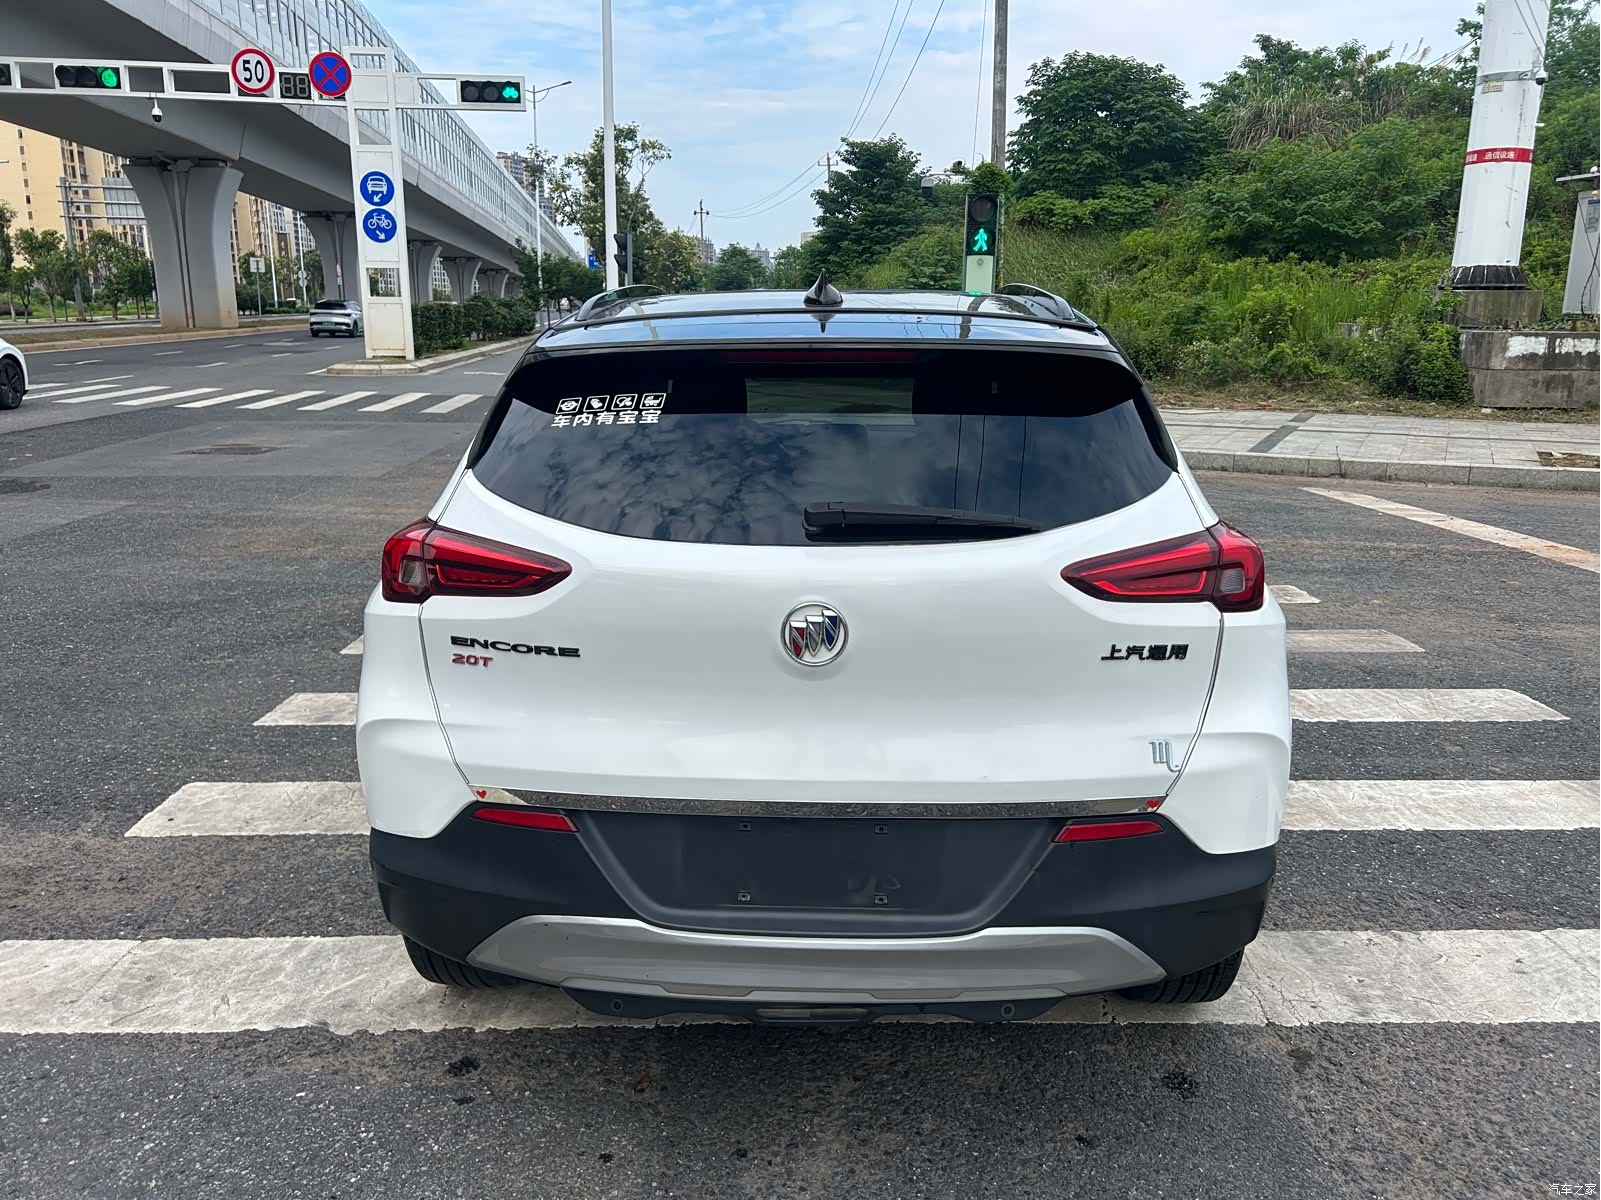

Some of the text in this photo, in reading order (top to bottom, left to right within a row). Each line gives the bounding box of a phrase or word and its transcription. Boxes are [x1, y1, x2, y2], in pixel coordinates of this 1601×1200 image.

[242, 60, 265, 83] 50
[1484, 151, 1515, 160] 通信设施
[551, 410, 662, 428] 车内有宝宝
[450, 635, 581, 657] ENCORE
[1100, 644, 1189, 661] 上汽通用
[451, 653, 494, 668] 20T
